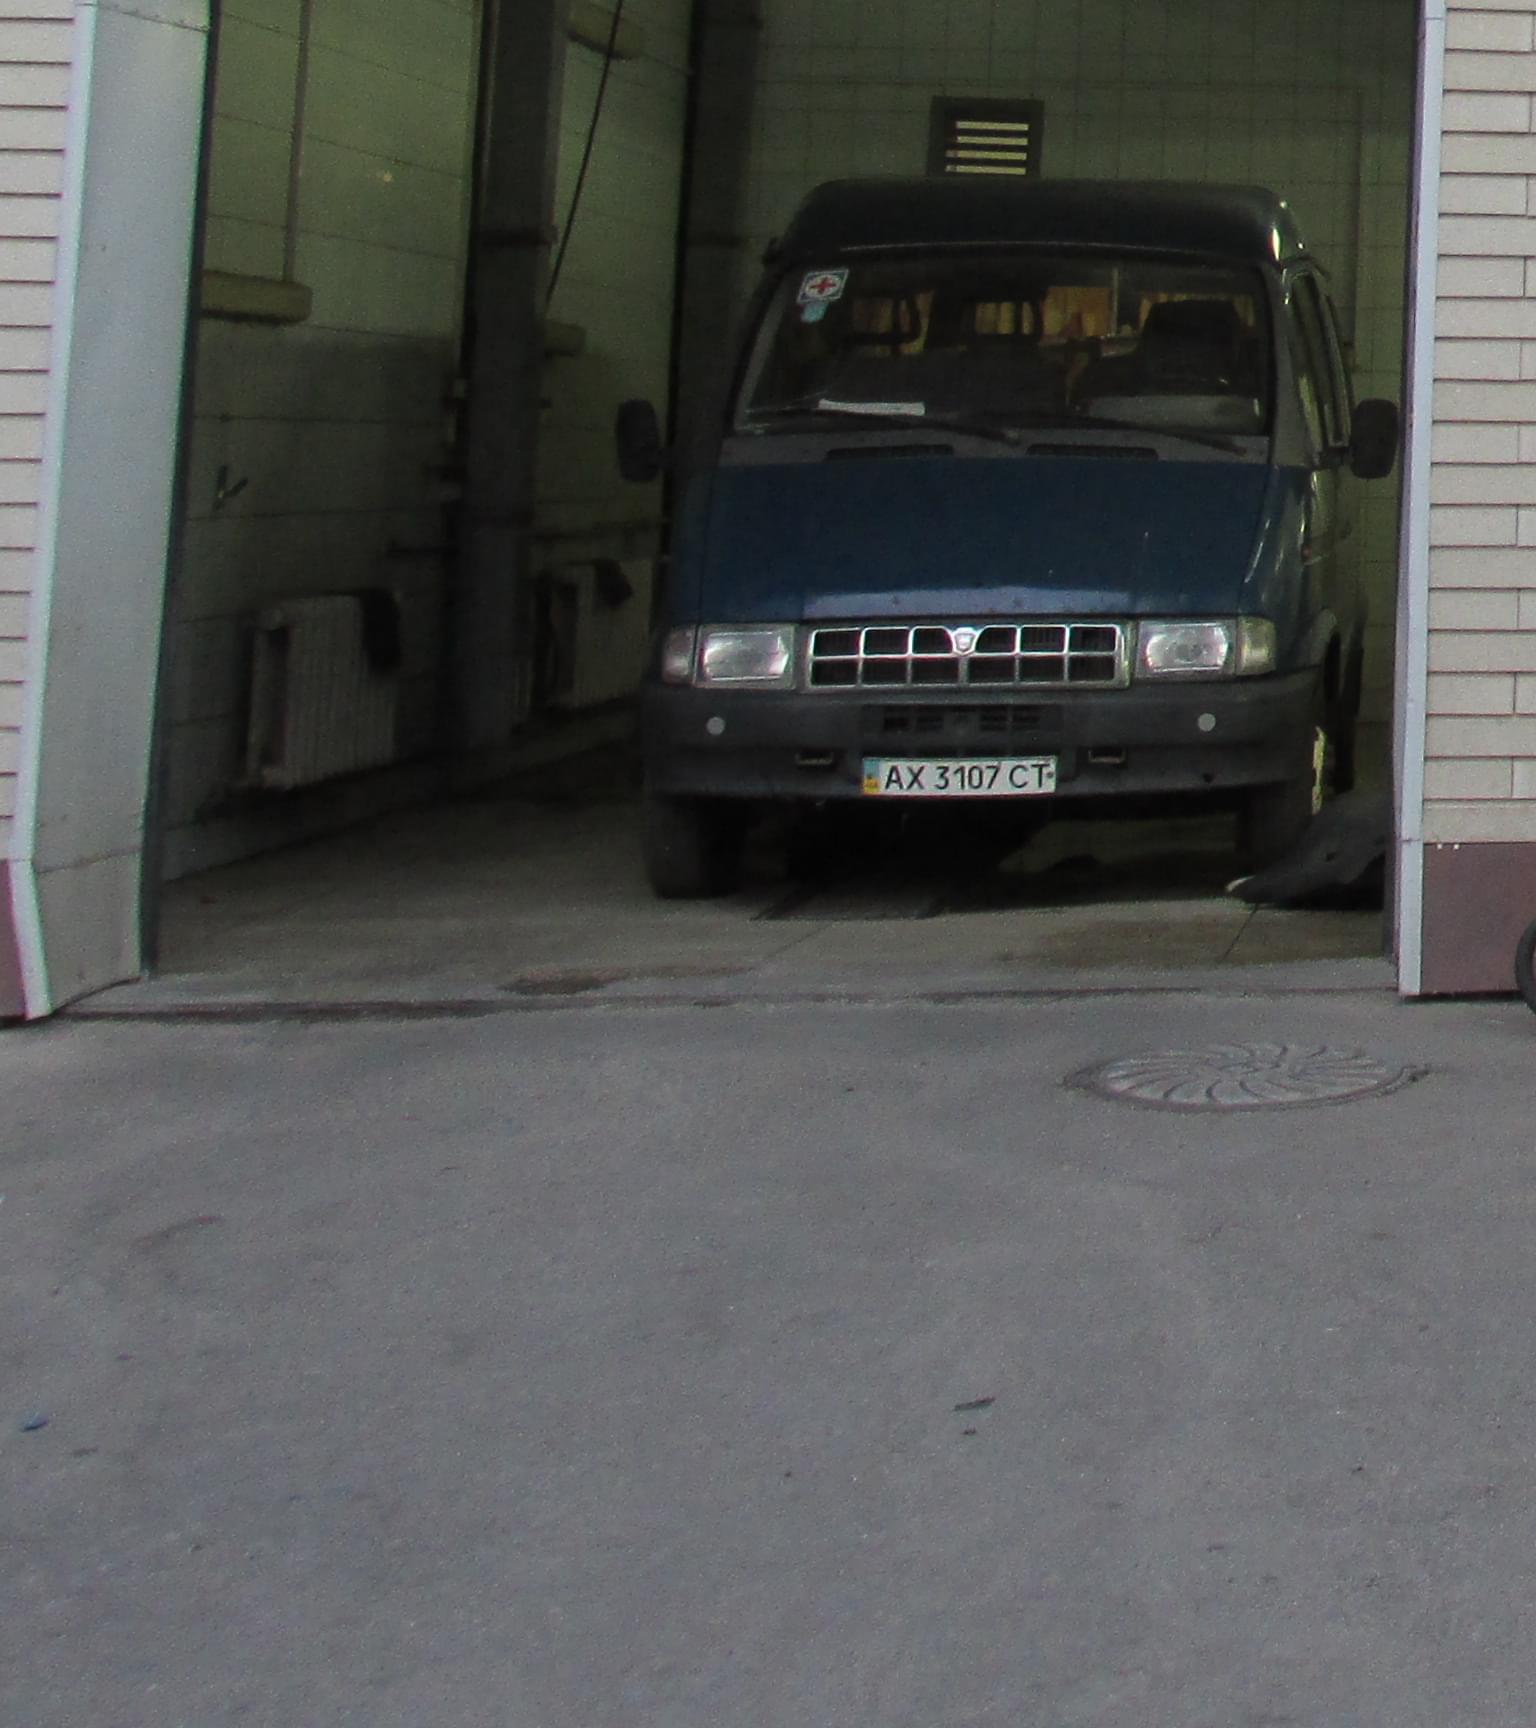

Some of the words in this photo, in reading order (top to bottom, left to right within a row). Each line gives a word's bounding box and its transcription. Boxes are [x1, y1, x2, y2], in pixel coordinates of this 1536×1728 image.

[884, 764, 925, 791] AX
[935, 764, 1001, 791] 3107
[1008, 763, 1051, 790] CT
